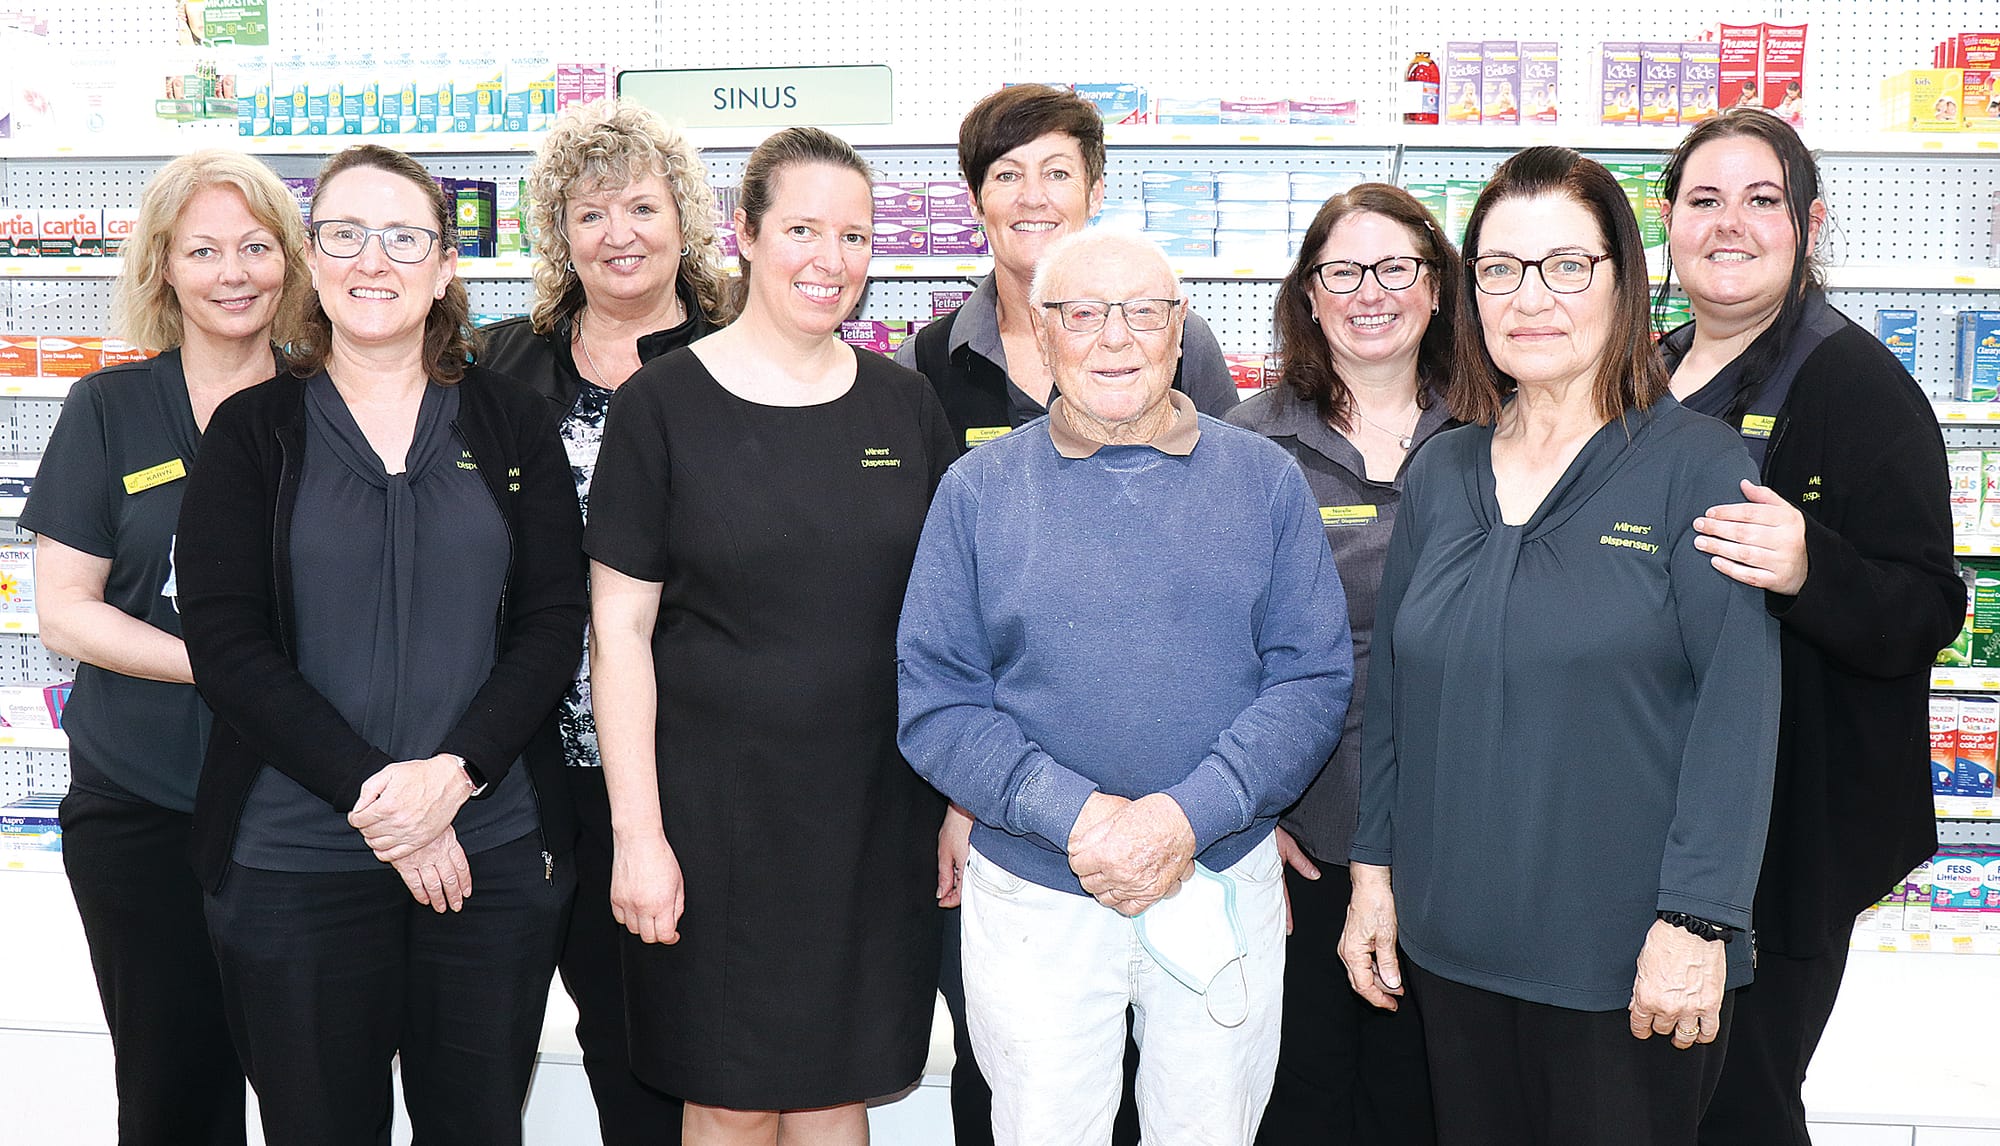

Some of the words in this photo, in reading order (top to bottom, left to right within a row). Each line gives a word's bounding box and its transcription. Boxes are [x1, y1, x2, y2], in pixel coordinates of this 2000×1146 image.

[1722, 40, 1758, 49] TYLENOL
[1767, 40, 1803, 49] TYLENOL
[714, 86, 797, 110] SINUS
[0, 214, 33, 235] rtia
[43, 214, 97, 235] cartia
[108, 220, 137, 235] car
[842, 329, 874, 339] Telfast
[865, 447, 889, 456] Miners'
[861, 458, 900, 468] Dispensary
[146, 469, 173, 482] KARYN
[1954, 475, 1977, 489] ids
[1613, 521, 1651, 535] Miners'
[1599, 535, 1659, 554] Dispensary
[1962, 716, 1996, 724] DEMAZIN
[1930, 734, 1945, 742] ugh
[1960, 734, 1985, 743] cough
[2, 816, 23, 825] Aspro
[2, 825, 23, 833] Clear
[1947, 865, 1972, 874] FESS
[1936, 873, 1957, 881] Little
